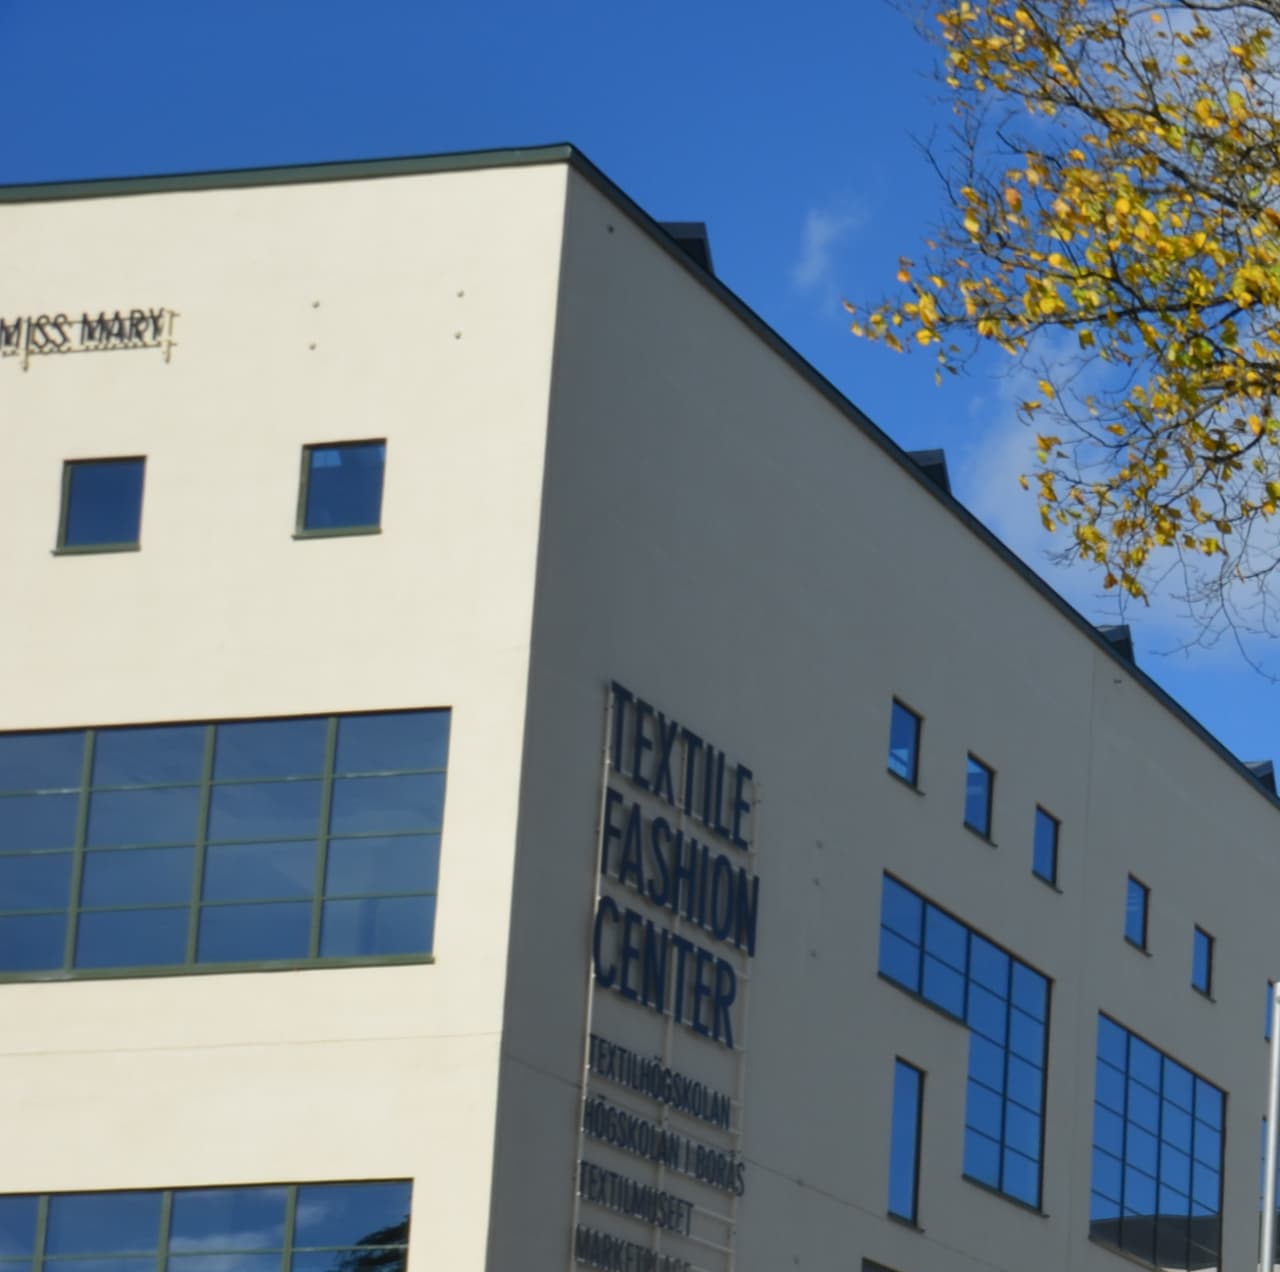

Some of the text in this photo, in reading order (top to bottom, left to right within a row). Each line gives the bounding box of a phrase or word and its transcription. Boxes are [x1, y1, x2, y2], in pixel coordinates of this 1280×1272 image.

[0, 307, 165, 350] MISS MARY
[608, 679, 754, 852] TEXTILE
[600, 786, 760, 958] FASHION
[592, 894, 738, 1049] CENTER
[589, 1033, 732, 1131] TEXTILHÖGSKOLAN
[584, 1093, 681, 1170] HÖGSKOLAN
[695, 1145, 746, 1197] BORÅS
[579, 1160, 694, 1236] TEXTILMUSEET
